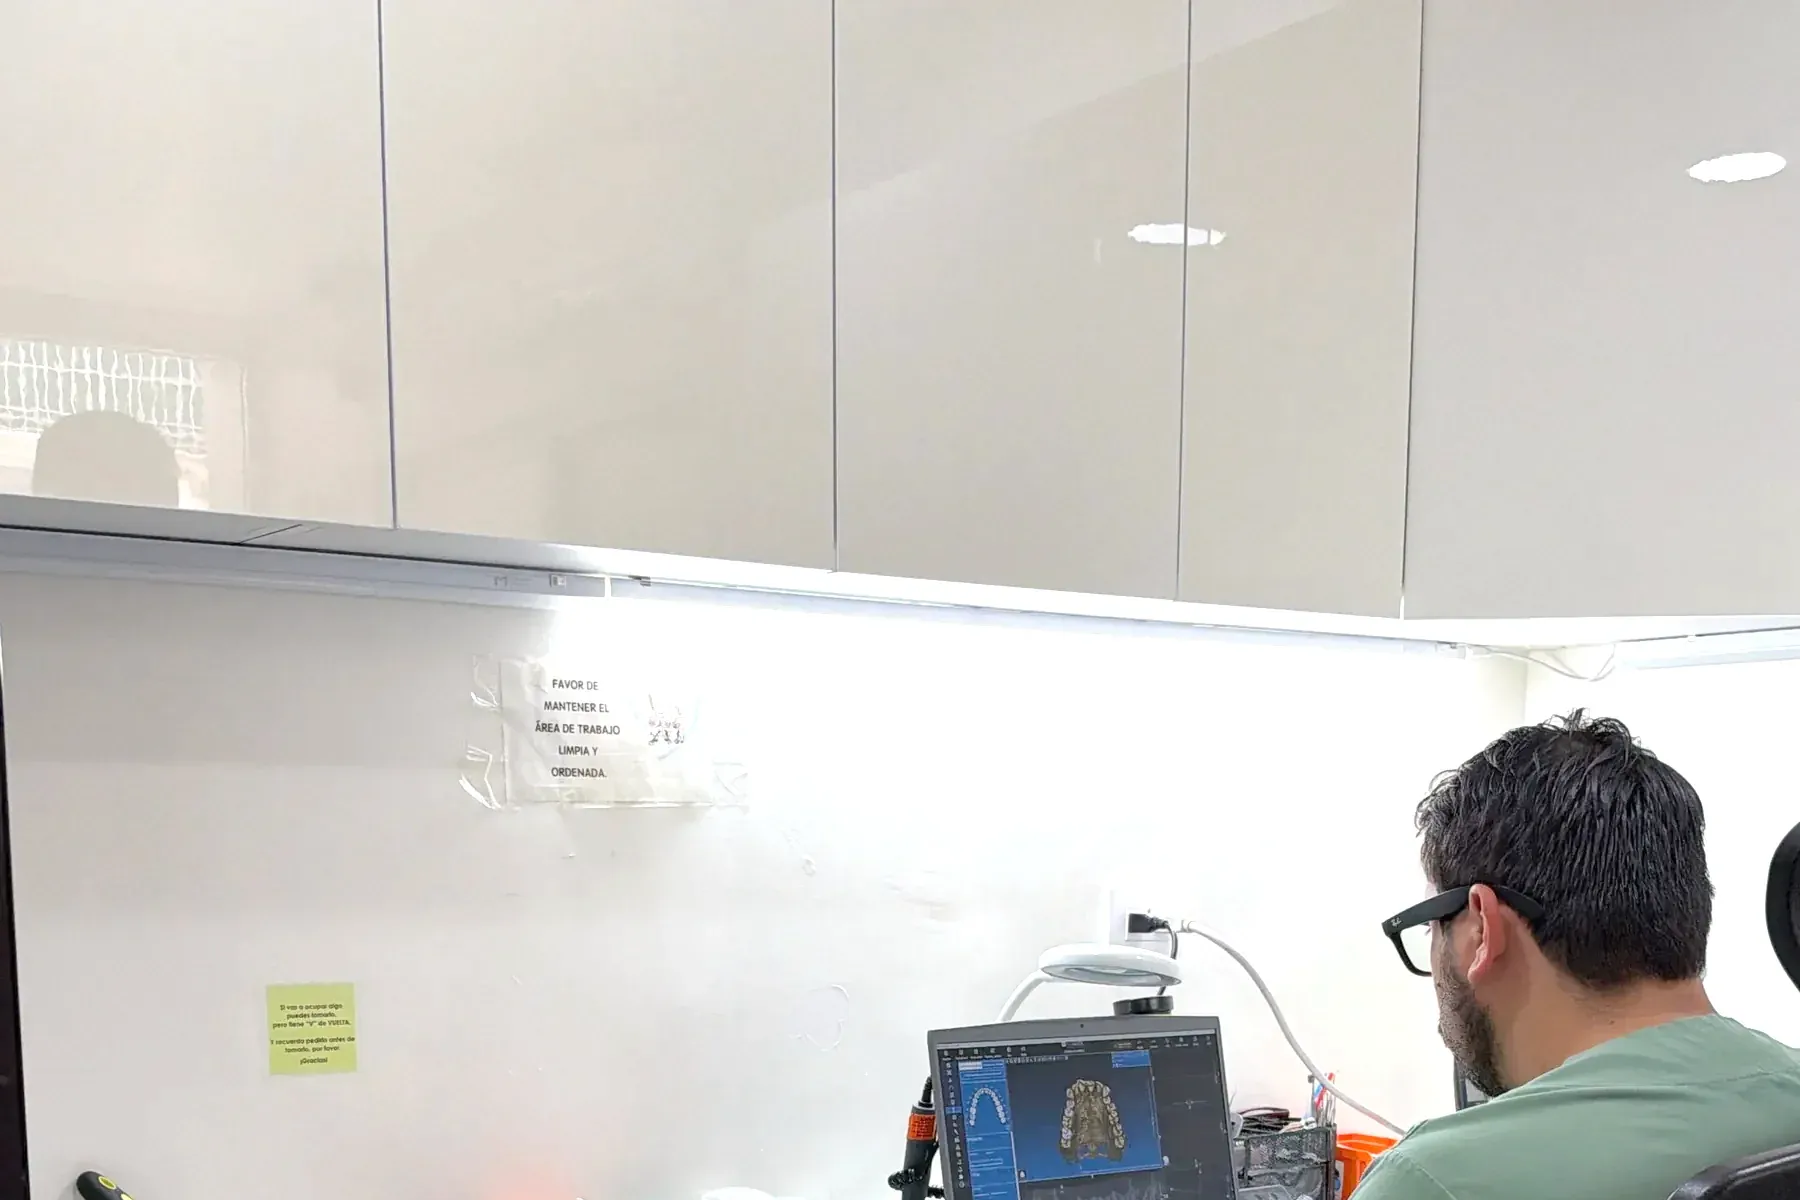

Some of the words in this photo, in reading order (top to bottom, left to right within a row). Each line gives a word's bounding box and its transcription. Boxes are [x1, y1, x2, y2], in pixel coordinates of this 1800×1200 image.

[552, 679, 584, 690] FAVOR
[586, 681, 599, 690] DE
[544, 701, 596, 712] MANTENER
[599, 703, 609, 713] EL
[535, 720, 560, 733] ÁREA
[562, 723, 575, 733] DE
[577, 724, 621, 735] TRABAJO
[558, 745, 590, 756] LIMPIA
[592, 746, 598, 756] Y
[551, 767, 607, 778] ORDENADA.
